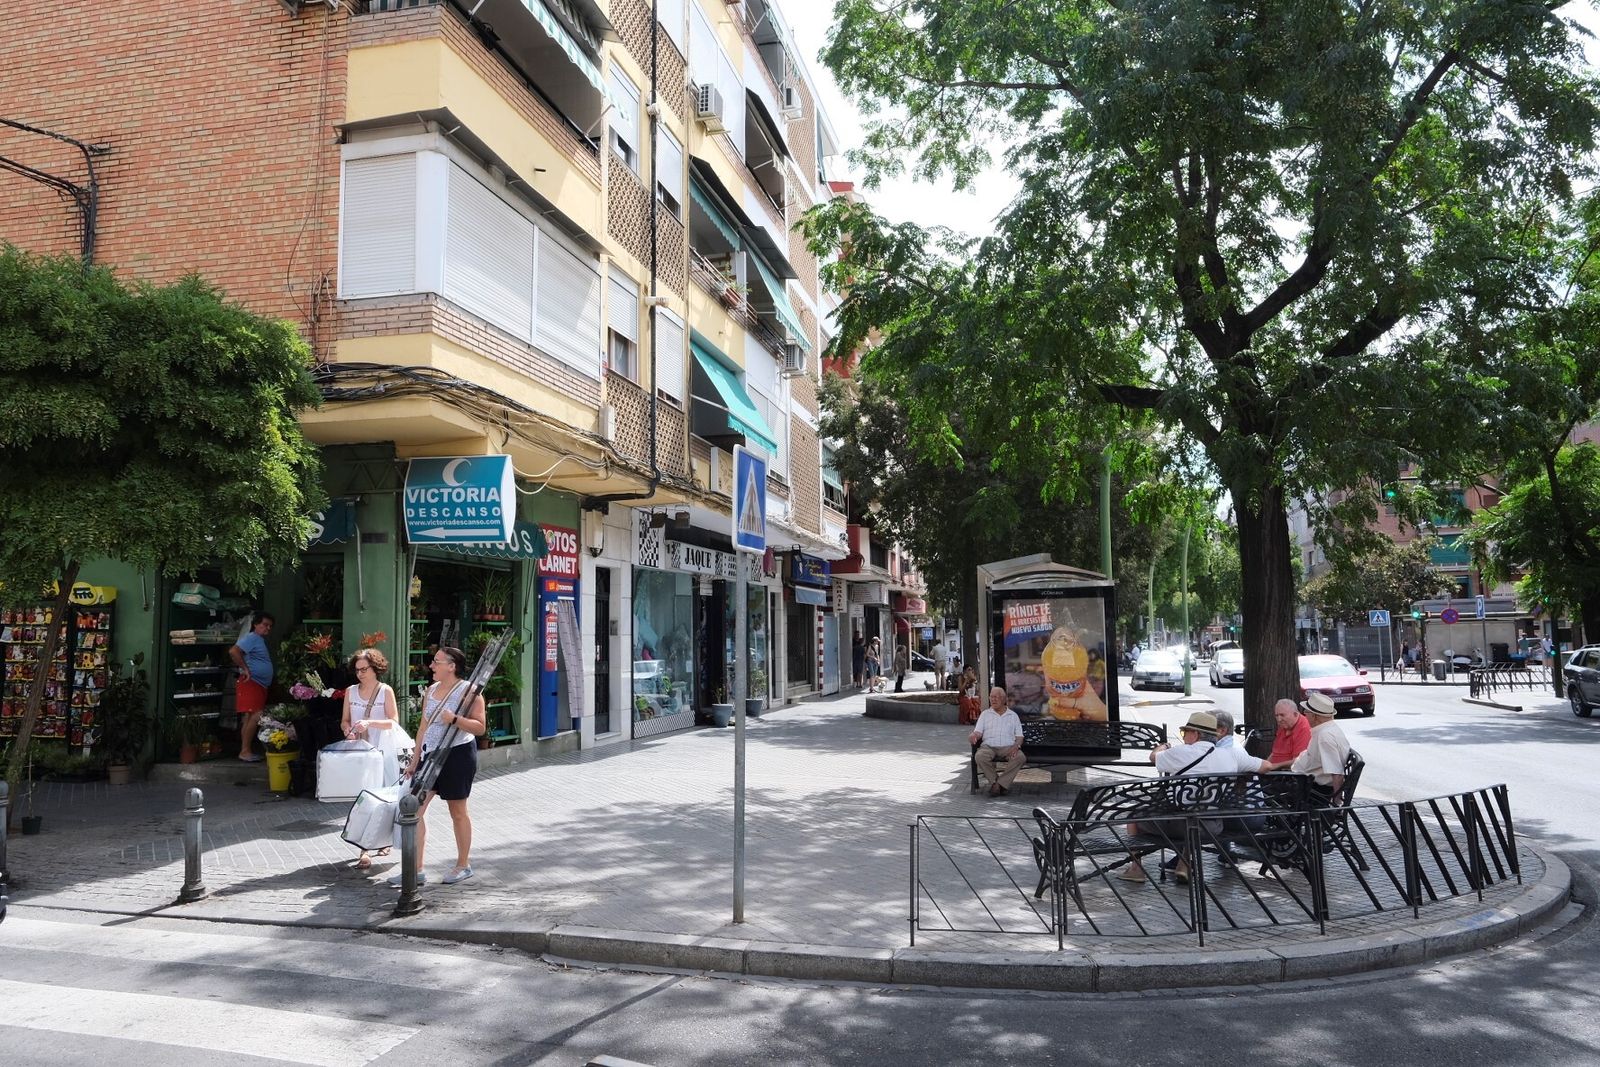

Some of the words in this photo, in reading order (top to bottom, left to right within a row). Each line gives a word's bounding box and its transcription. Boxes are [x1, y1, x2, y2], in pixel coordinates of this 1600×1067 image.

[407, 487, 500, 504] VICTORIA
[407, 507, 501, 518] DESCANSO
[540, 554, 577, 574] CARNET
[685, 547, 712, 571] JAQUE
[1010, 603, 1051, 619] RÍNDETE
[1011, 625, 1032, 635] NUEVO
[1032, 623, 1053, 633] SABOR
[1018, 616, 1052, 626] IRRESISTLE
